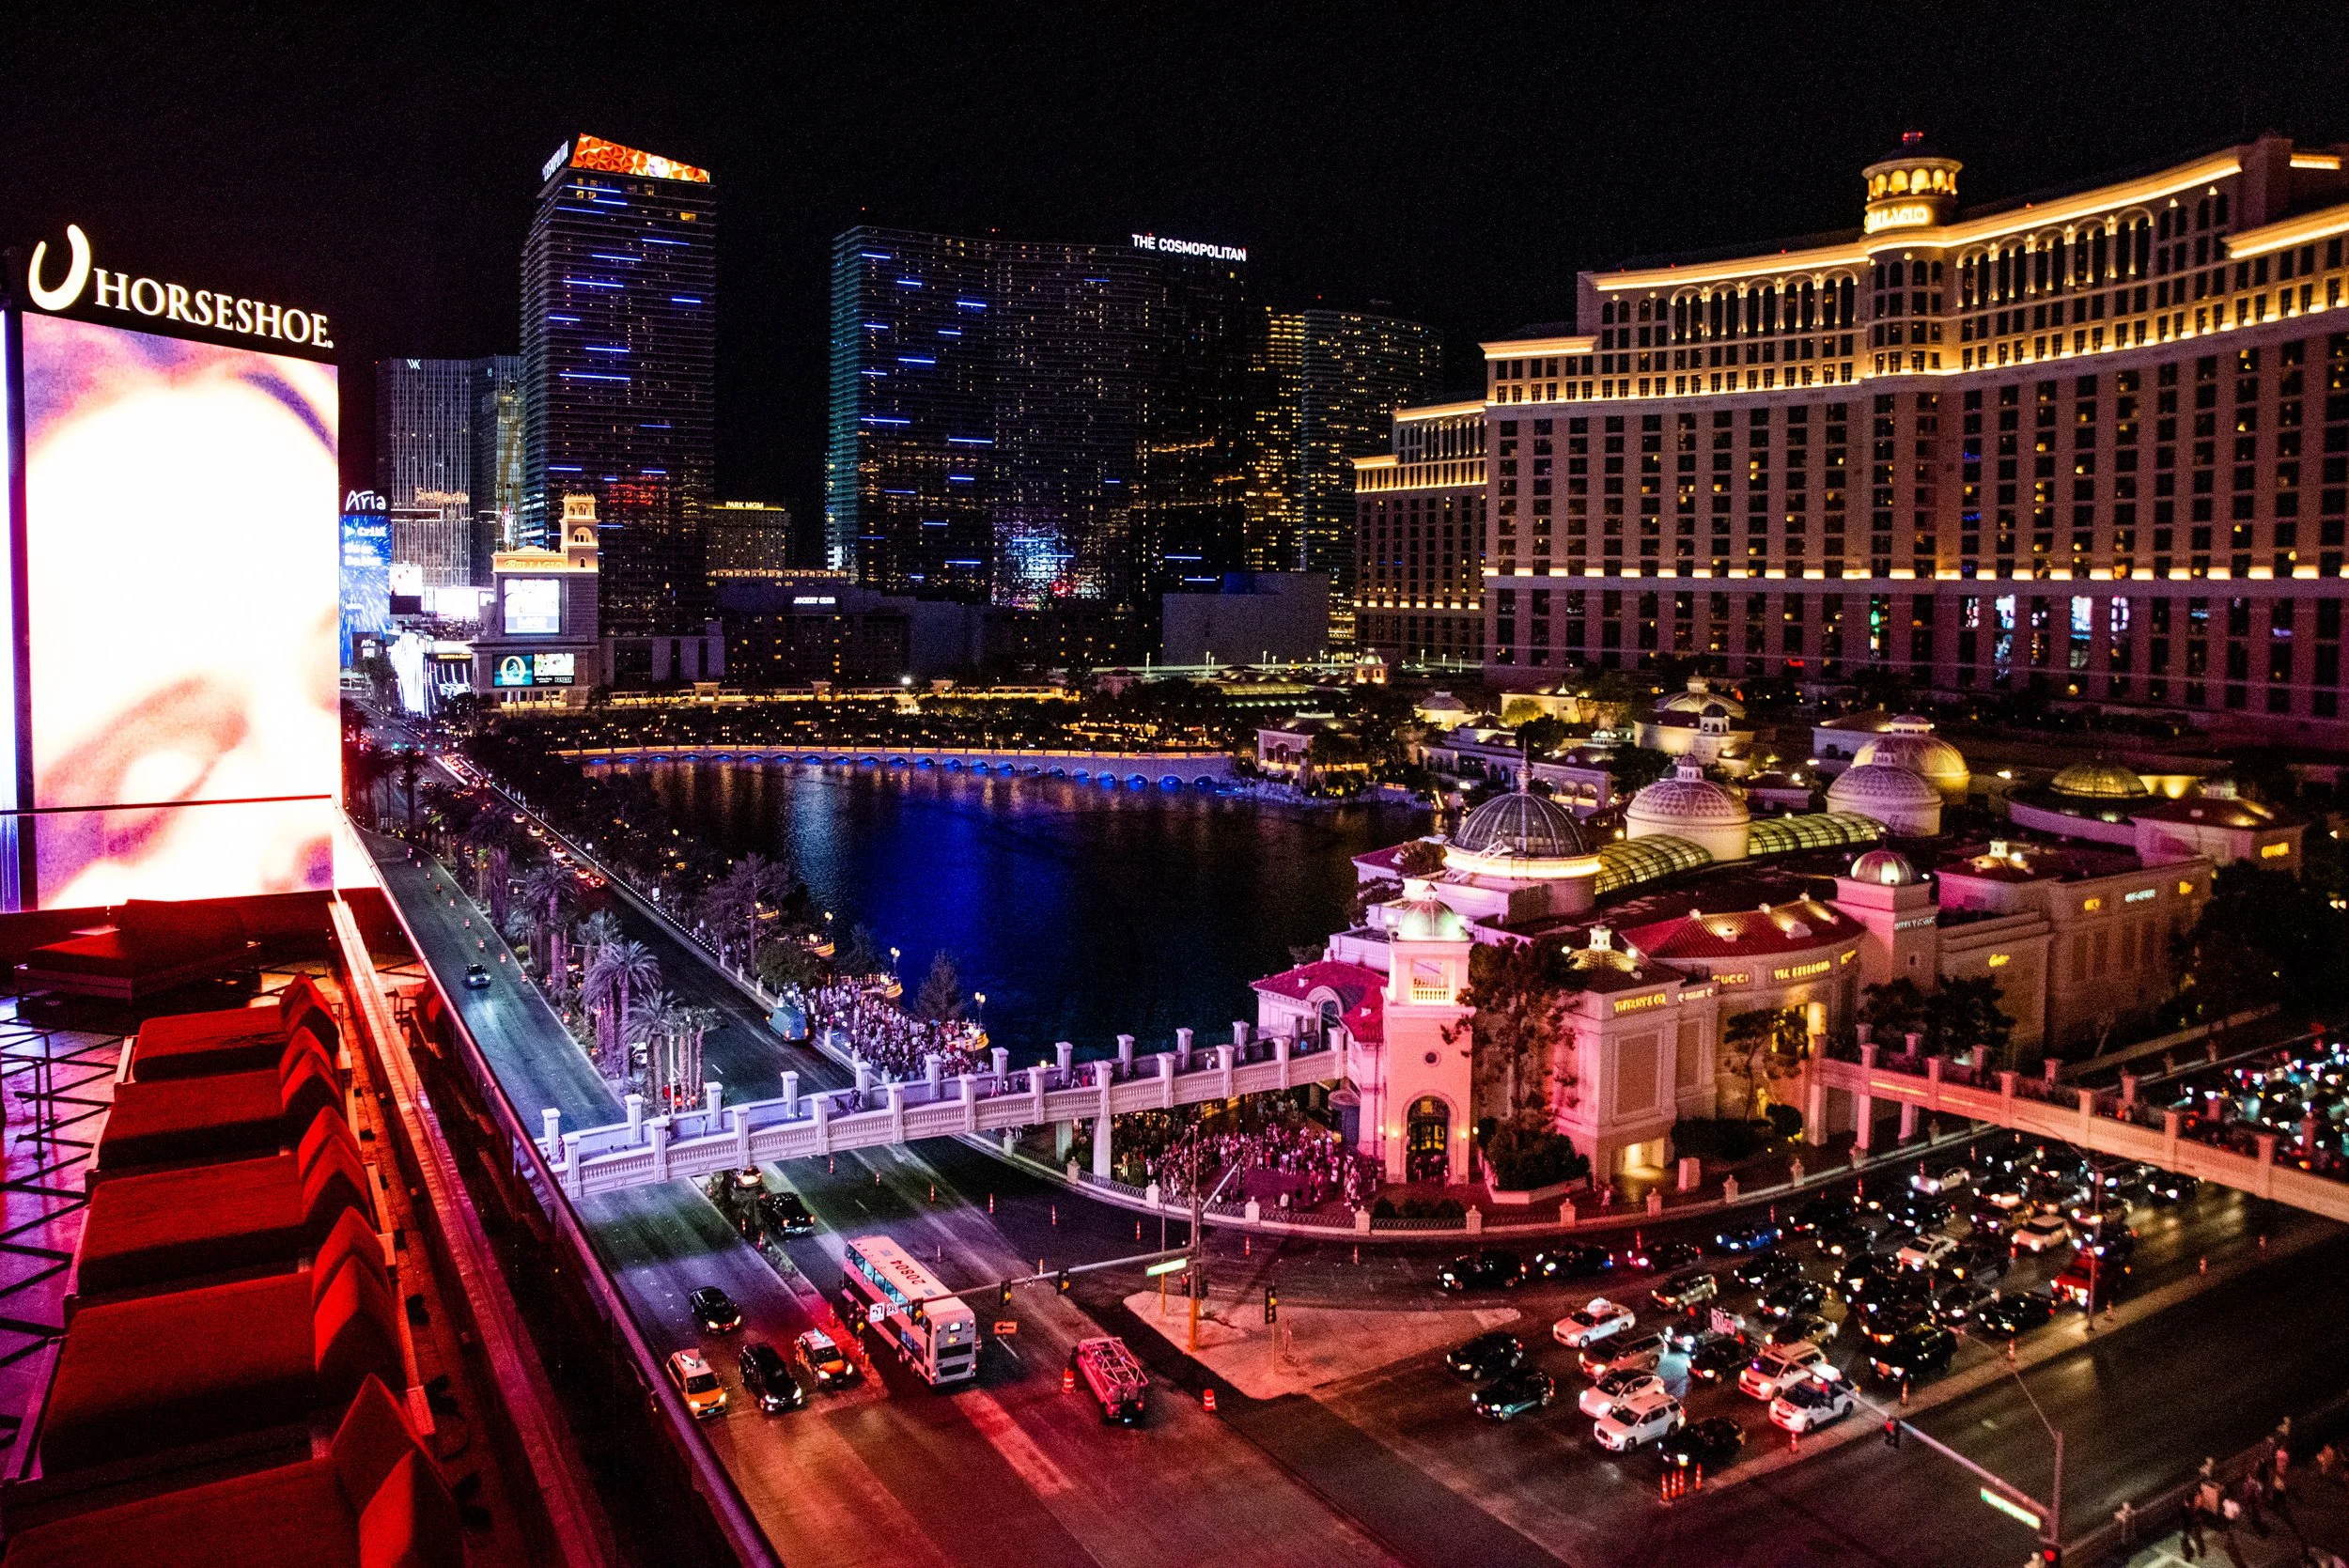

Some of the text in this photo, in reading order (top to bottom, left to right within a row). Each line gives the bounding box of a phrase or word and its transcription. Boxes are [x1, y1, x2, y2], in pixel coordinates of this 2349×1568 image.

[1131, 234, 1247, 262] THE COSMOPOLITAN
[94, 267, 330, 349] HORSESHOE
[345, 489, 386, 511] Aria
[725, 501, 764, 510] PARK MGM
